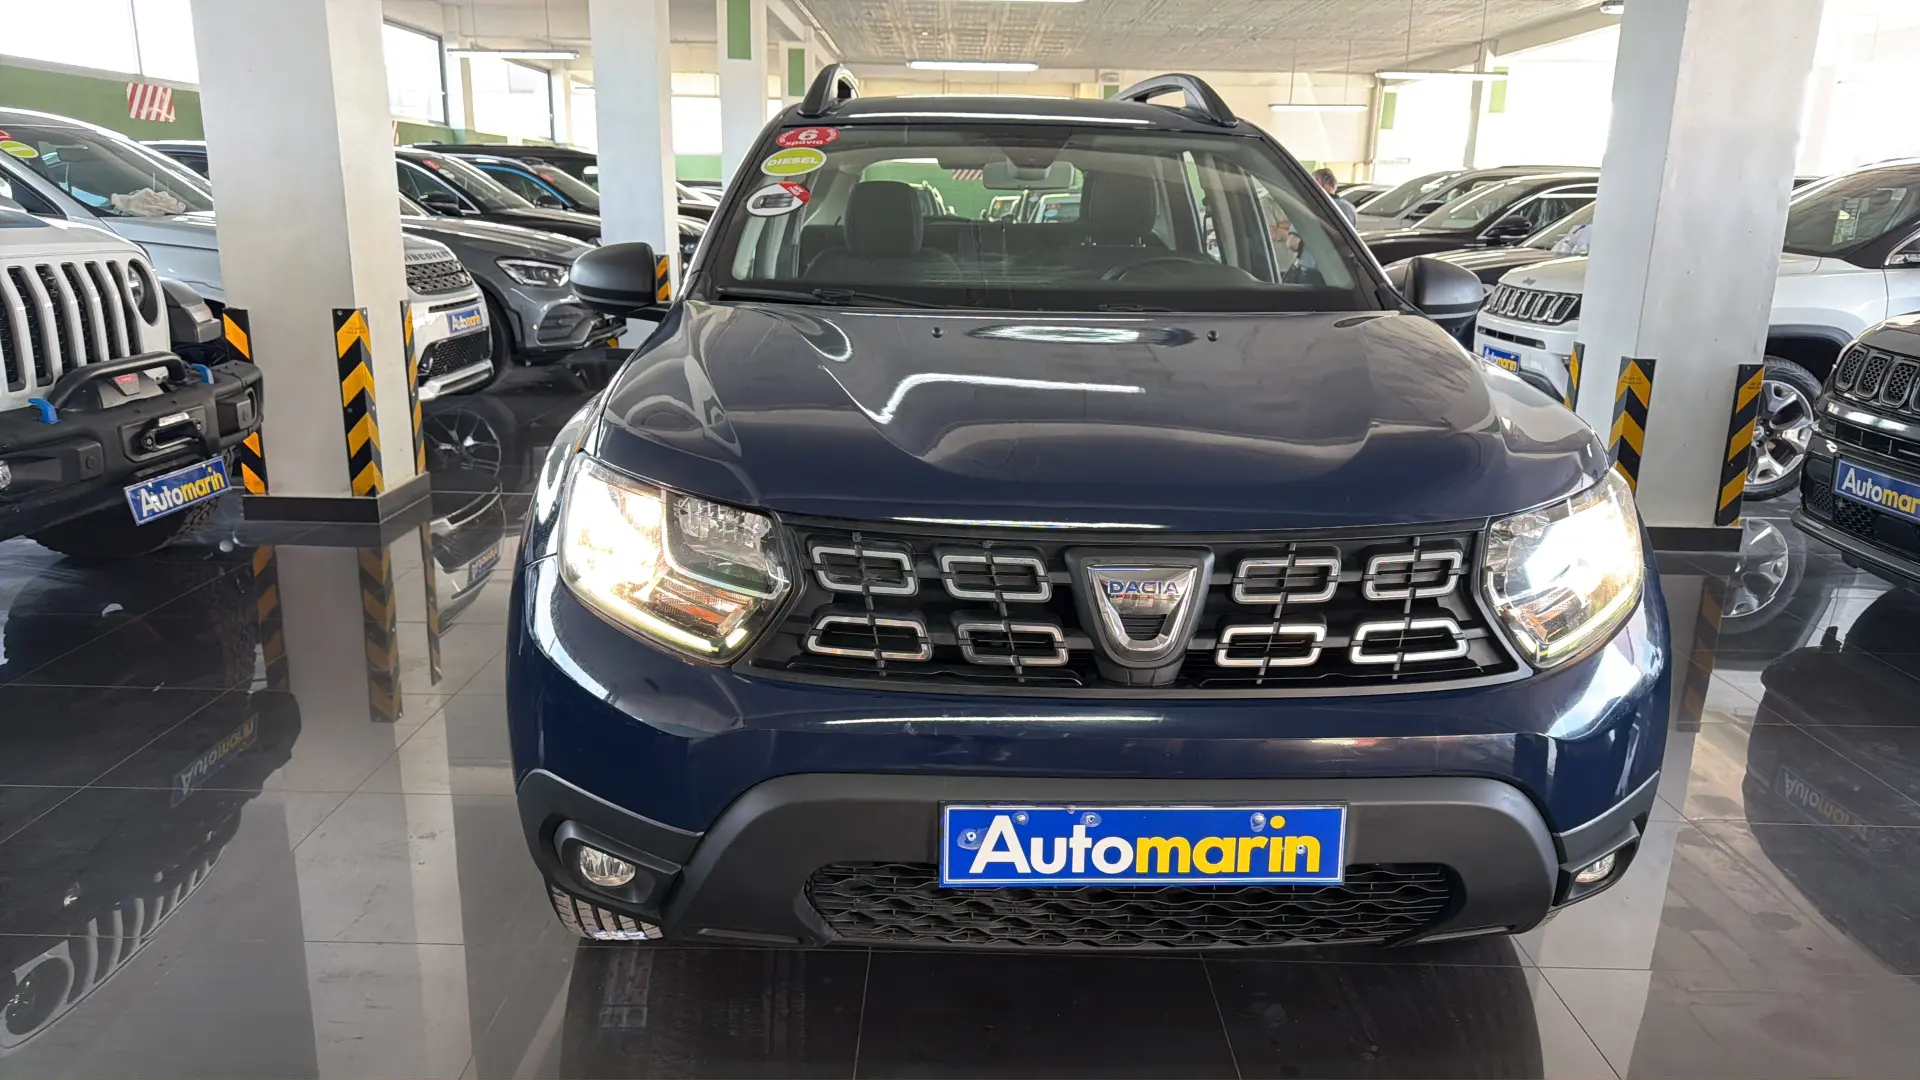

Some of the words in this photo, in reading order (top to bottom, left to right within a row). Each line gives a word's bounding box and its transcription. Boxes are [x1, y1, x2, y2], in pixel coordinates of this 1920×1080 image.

[798, 129, 819, 141] 6
[767, 156, 819, 167] DIESEL
[140, 466, 225, 517] Automarin
[1841, 467, 1920, 514] Automar
[1108, 580, 1179, 594] DACIA
[968, 814, 1321, 875] Automarin
